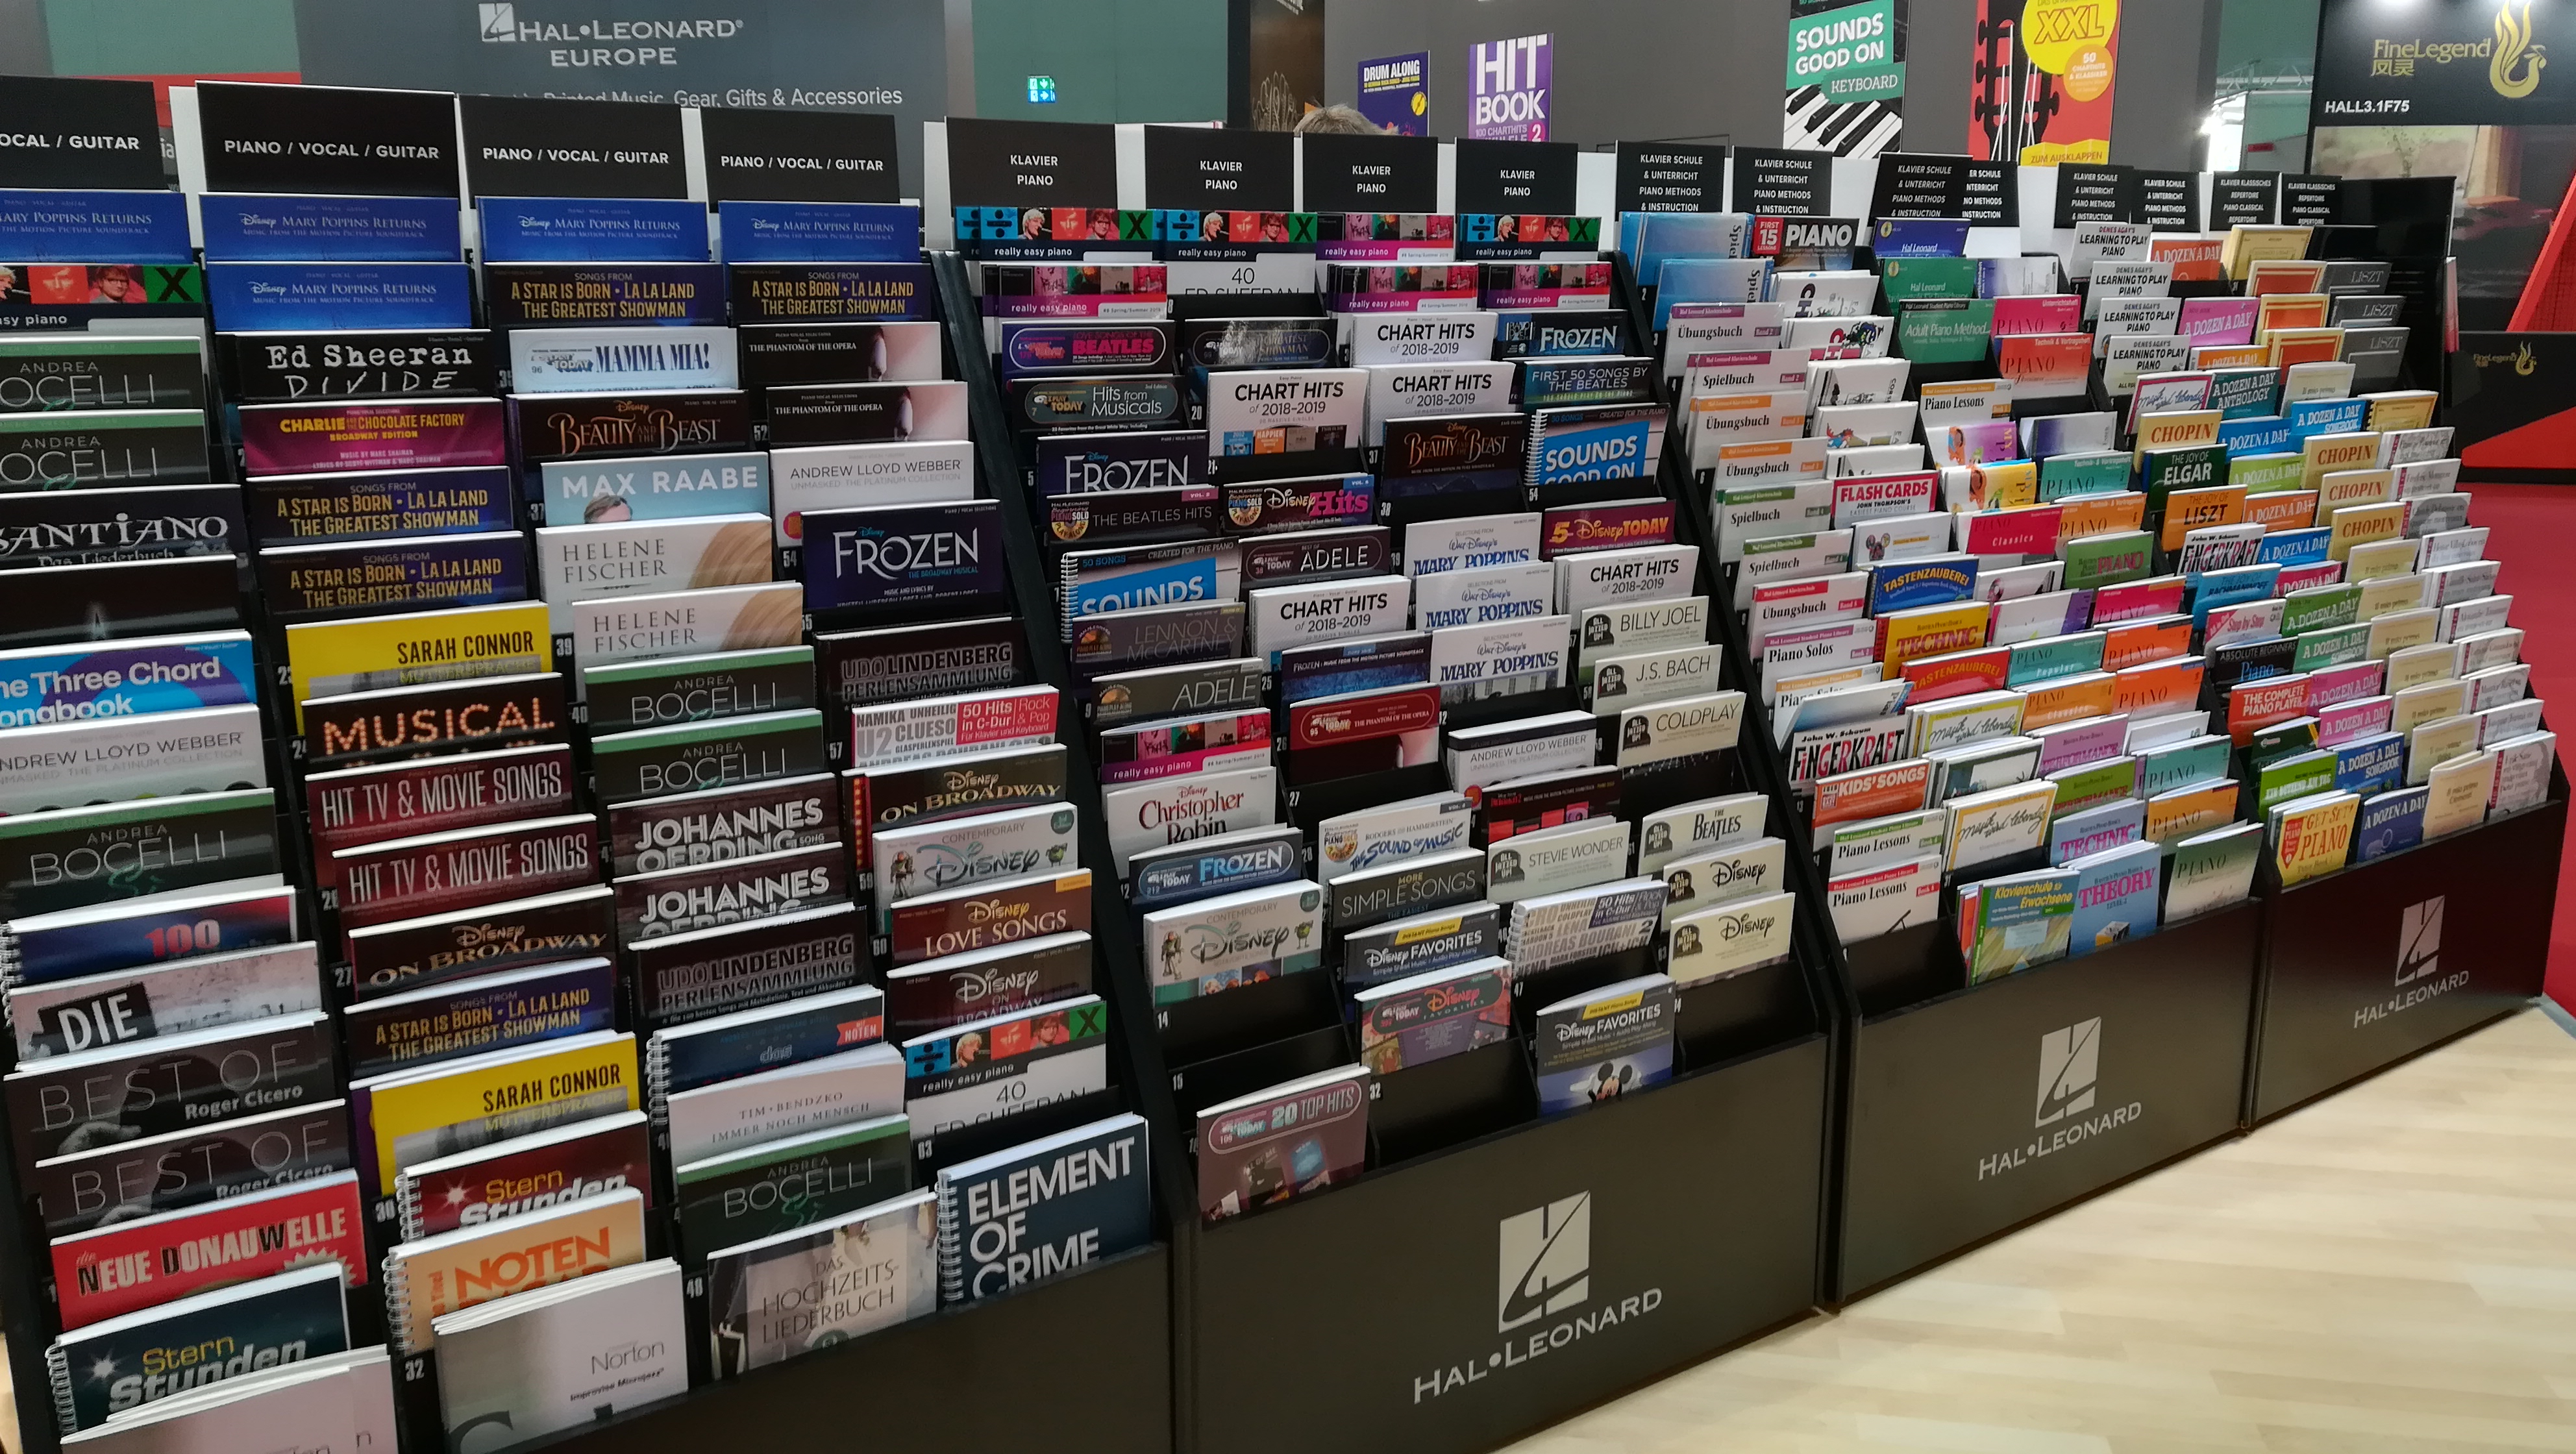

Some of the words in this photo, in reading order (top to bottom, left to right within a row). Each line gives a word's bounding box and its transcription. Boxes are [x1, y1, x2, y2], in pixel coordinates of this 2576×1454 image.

[1796, 13, 1884, 52] SOUNDS
[2034, 6, 2106, 44] XXL
[551, 47, 678, 67] EUROPE
[1796, 47, 1851, 75] GOOD
[1855, 40, 1884, 64] ON
[2373, 38, 2491, 64] FineLegend
[1363, 62, 1390, 82] DRUM
[1391, 59, 1420, 79] ALONG
[1476, 34, 1548, 95] HIT
[726, 88, 767, 108] Gifts
[772, 89, 786, 105] &
[791, 86, 903, 106] Accessories
[1831, 74, 1898, 95] KEYBOARD
[1476, 90, 1546, 125] BOOK
[2324, 100, 2410, 114] HALL3.1F75
[1531, 123, 1542, 143] 2
[225, 139, 281, 155] PIANO
[299, 142, 359, 158] VOCAL
[376, 144, 440, 160] GUITAR
[1010, 154, 1058, 166] KLAVIER
[1640, 154, 1672, 164] KLAVIER
[1674, 156, 1703, 165] SCHULE
[2031, 153, 2049, 164] ZUM
[2050, 151, 2103, 163] AUSKLAPPEN
[1017, 174, 1054, 186] PIANO
[1352, 165, 1391, 176] KLAVIER
[1652, 170, 1698, 180] UNTERRICHT
[1357, 183, 1387, 193] PIANO
[1639, 187, 1663, 196] PIANO
[1665, 187, 1702, 197] METHODS
[1648, 202, 1699, 212] INSTRUCTION
[554, 217, 585, 230] MARY
[588, 218, 628, 231] POPPINS
[632, 219, 680, 232] RETURNS
[994, 245, 1022, 258] really
[1024, 247, 1045, 257] easy
[1048, 245, 1072, 257] piano
[1231, 267, 1256, 284] 40
[752, 282, 762, 297] A
[763, 281, 791, 297] STAR
[795, 281, 806, 296] IS
[809, 280, 840, 296] BORN
[761, 299, 784, 314] THE
[787, 298, 845, 314] GREATEST
[847, 299, 905, 314] SHOWMAN
[1678, 325, 1742, 340] Übungsbuch
[265, 344, 311, 370] Ed
[323, 343, 473, 367] Sheeran
[596, 343, 666, 373] MAMMA
[670, 343, 710, 371] MIA!
[1072, 338, 1154, 356] BEATLES
[2136, 360, 2161, 370] PIANO
[284, 370, 459, 399] DIVIDE
[1235, 383, 1299, 402] CHART
[1304, 382, 1344, 399] HITS
[1702, 372, 1755, 387] Spielbuch
[1092, 386, 1121, 404] Hits
[1124, 388, 1148, 400] from
[1091, 399, 1162, 417] Musicals
[1191, 405, 1202, 421] 20
[279, 417, 345, 432] CHARLIE
[358, 415, 418, 430] CHOCOLATE
[419, 413, 465, 428] FACTORY
[2150, 422, 2213, 443] CHOPIN
[1544, 435, 1638, 473] SOUNDS
[2318, 445, 2373, 465] CHOPIN
[653, 465, 758, 492] RAABE
[790, 465, 852, 480] ANDREW
[857, 462, 900, 476] LLOYD
[905, 460, 961, 474] WEBBER
[2163, 462, 2212, 486] ELGAR
[1840, 483, 1883, 503] FLASH
[1885, 479, 1928, 500] CARDS
[1310, 491, 1370, 518] Hits
[2183, 504, 2228, 525] LISZT
[1623, 517, 1669, 537] TODAY
[564, 538, 665, 563] HELENE
[832, 526, 979, 581] FROZEN
[1300, 545, 1369, 573] ADELE
[564, 560, 668, 584] FISCHER
[1884, 568, 1970, 593] TASTENZAUBEREI
[1620, 609, 1661, 633] BILLY
[1662, 605, 1701, 627] JOEL
[397, 637, 456, 665] SARAH
[464, 631, 534, 658] CONNOR
[1768, 647, 1803, 663] Piano
[1806, 642, 1833, 657] Solos
[1896, 626, 1979, 657] TECHNIC
[1440, 659, 1485, 682] MARY
[1492, 650, 1558, 675] POPPINS
[1636, 661, 1661, 682] J.S.
[1666, 654, 1711, 676] BACH
[673, 675, 735, 691] ANDREA
[631, 682, 777, 726] BOCELLI
[962, 702, 982, 719] 50
[985, 701, 1013, 717] Hits
[1019, 696, 1050, 711] Rock
[324, 696, 555, 756] MUSICAL
[856, 710, 906, 728] NAMIKA
[962, 719, 973, 731] in
[975, 715, 1012, 730] C-Dur
[1655, 702, 1740, 732] COLDPLAY
[857, 727, 893, 759] U2
[895, 718, 956, 741] CLUESO
[1837, 773, 1876, 797] KIDS'
[1877, 765, 1926, 789] SONGS
[880, 801, 918, 823] ON
[924, 783, 1061, 811] BROADWAY
[1139, 791, 1244, 830] Christopher
[634, 797, 824, 852] JOHANNES
[1528, 849, 1568, 868] STEVIE
[1571, 837, 1623, 859] WONDER
[2298, 823, 2349, 862] PIANO
[349, 862, 382, 904] HIT
[390, 858, 417, 895] TV
[425, 854, 442, 892] &
[449, 844, 514, 889] MOVIE
[519, 832, 588, 878] SONGS
[1198, 846, 1283, 879] FROZEN
[1341, 889, 1407, 918] SIMPLE
[1410, 870, 1476, 901] SONGS
[1833, 889, 1866, 907] Piano
[1870, 881, 1907, 900] Lessons
[2079, 867, 2157, 909] THEORY
[924, 926, 983, 958] LOVE
[992, 909, 1068, 945] SONGS
[39, 1059, 193, 1132] BEST
[219, 1040, 299, 1092] OF
[185, 1096, 240, 1120] Roger
[244, 1083, 304, 1108] Cicero
[968, 1137, 1135, 1226] ELEMENT
[970, 1210, 1026, 1264] OF
[77, 1250, 153, 1298] NEUE
[161, 1207, 347, 1276] DONAUWELLE
[762, 1285, 895, 1345] LIEDERBUCH
[142, 1336, 235, 1375] Stern
[591, 1340, 665, 1375] Norton
